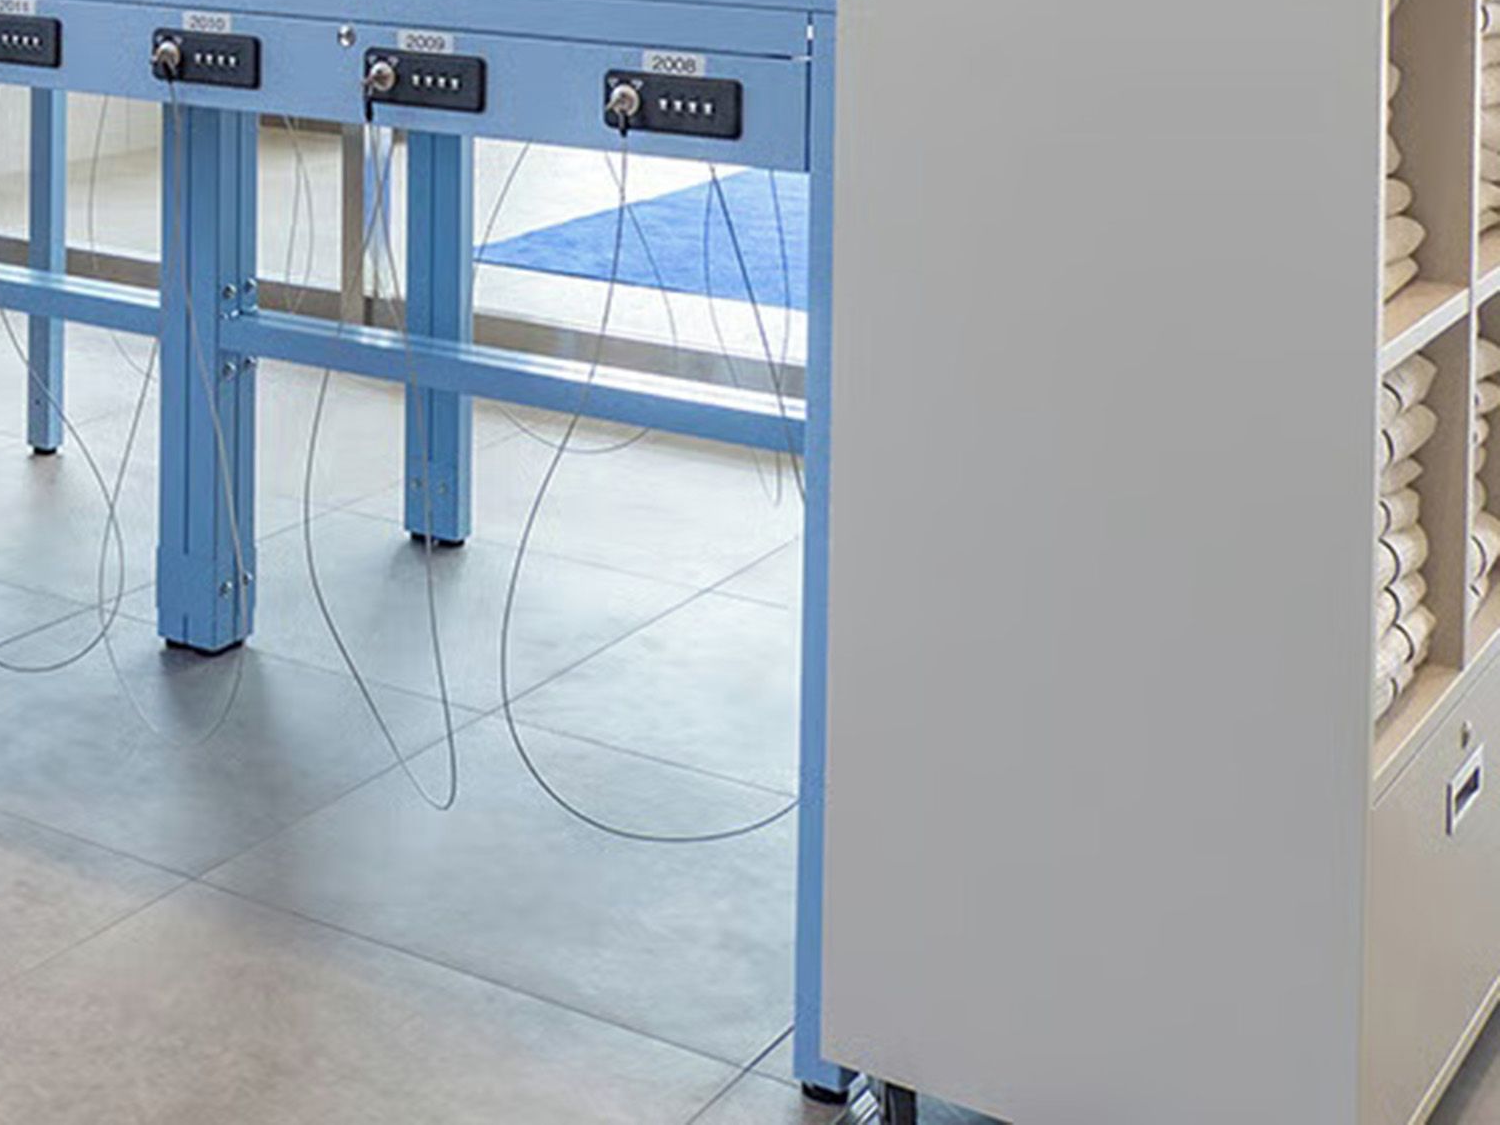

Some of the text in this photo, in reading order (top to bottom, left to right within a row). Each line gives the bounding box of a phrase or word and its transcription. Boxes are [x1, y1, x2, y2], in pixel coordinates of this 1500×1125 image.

[189, 14, 226, 31] 2010
[405, 33, 446, 50] 2009
[652, 54, 697, 74] 2008
